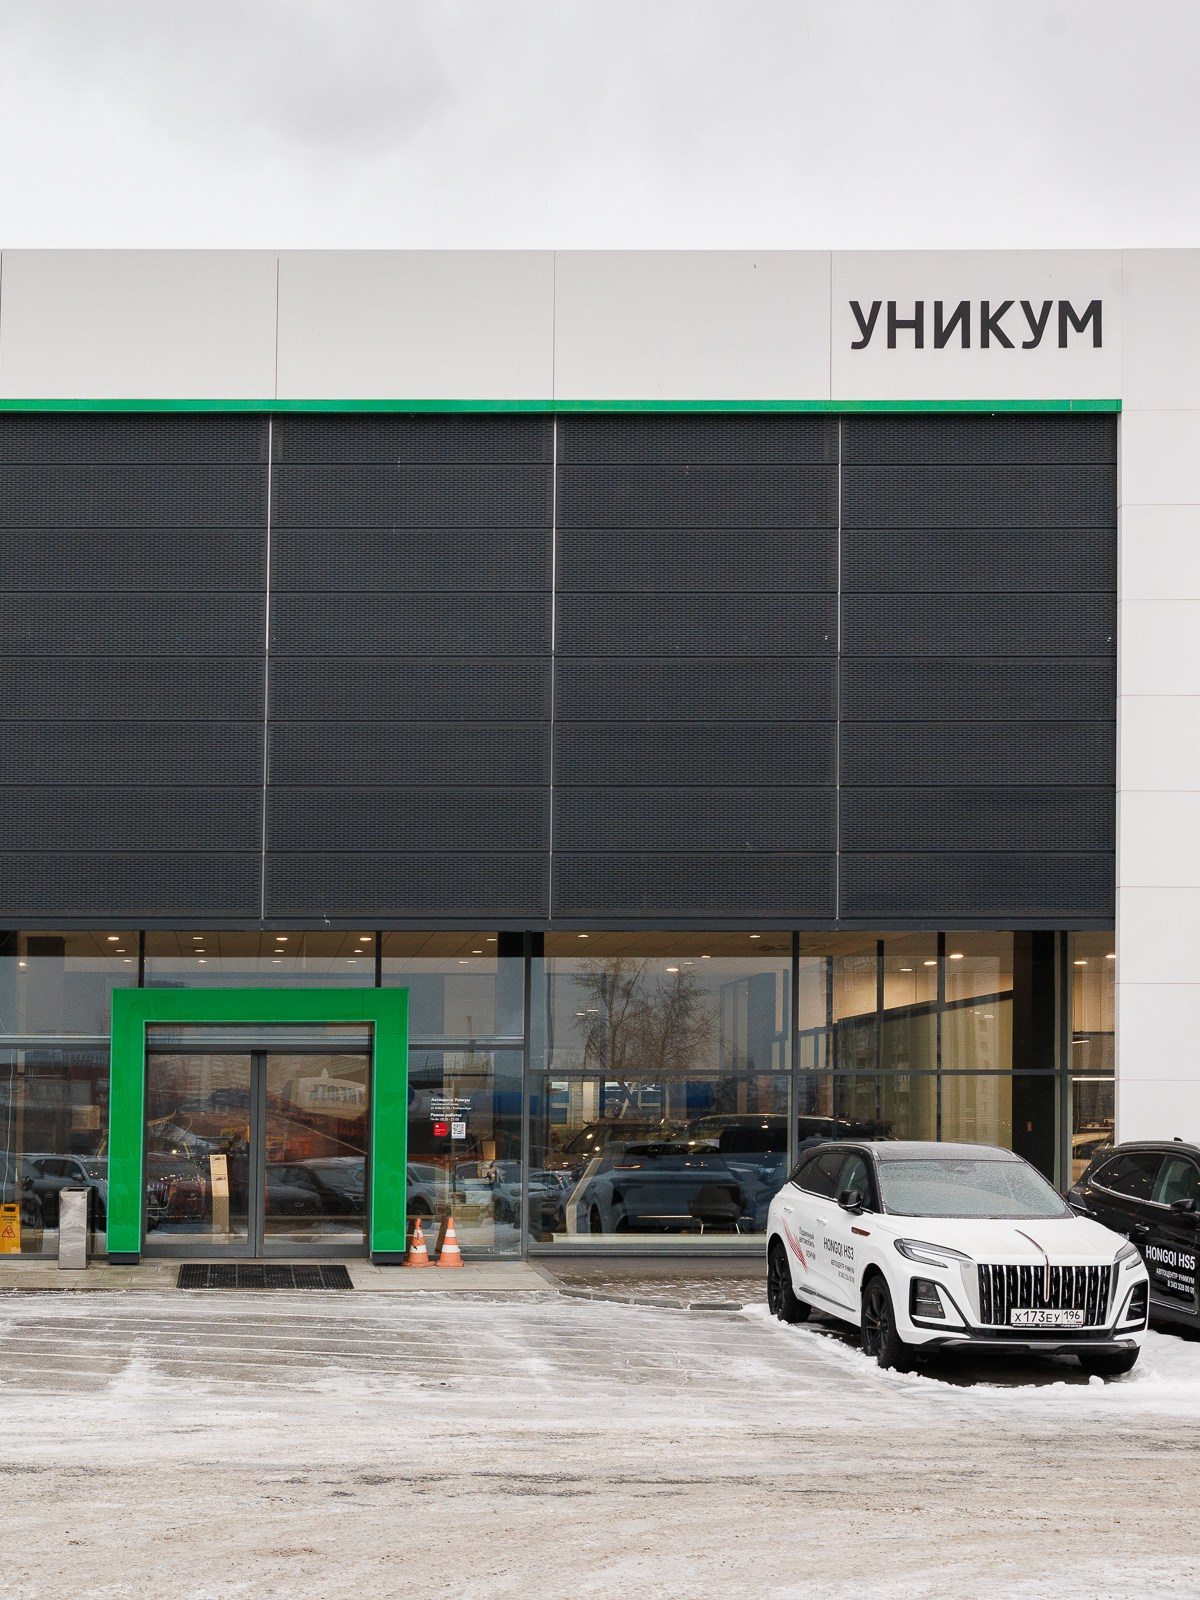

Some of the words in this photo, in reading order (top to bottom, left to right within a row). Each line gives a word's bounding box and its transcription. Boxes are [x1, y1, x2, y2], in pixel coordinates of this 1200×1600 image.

[849, 300, 1102, 349] УНИКУМ
[824, 1236, 843, 1257] HONGQI
[1145, 1245, 1177, 1266] HONGQI
[1178, 1252, 1195, 1270] HS5
[1014, 1311, 1060, 1322] Х173ЕУ
[1064, 1311, 1081, 1320] 196
